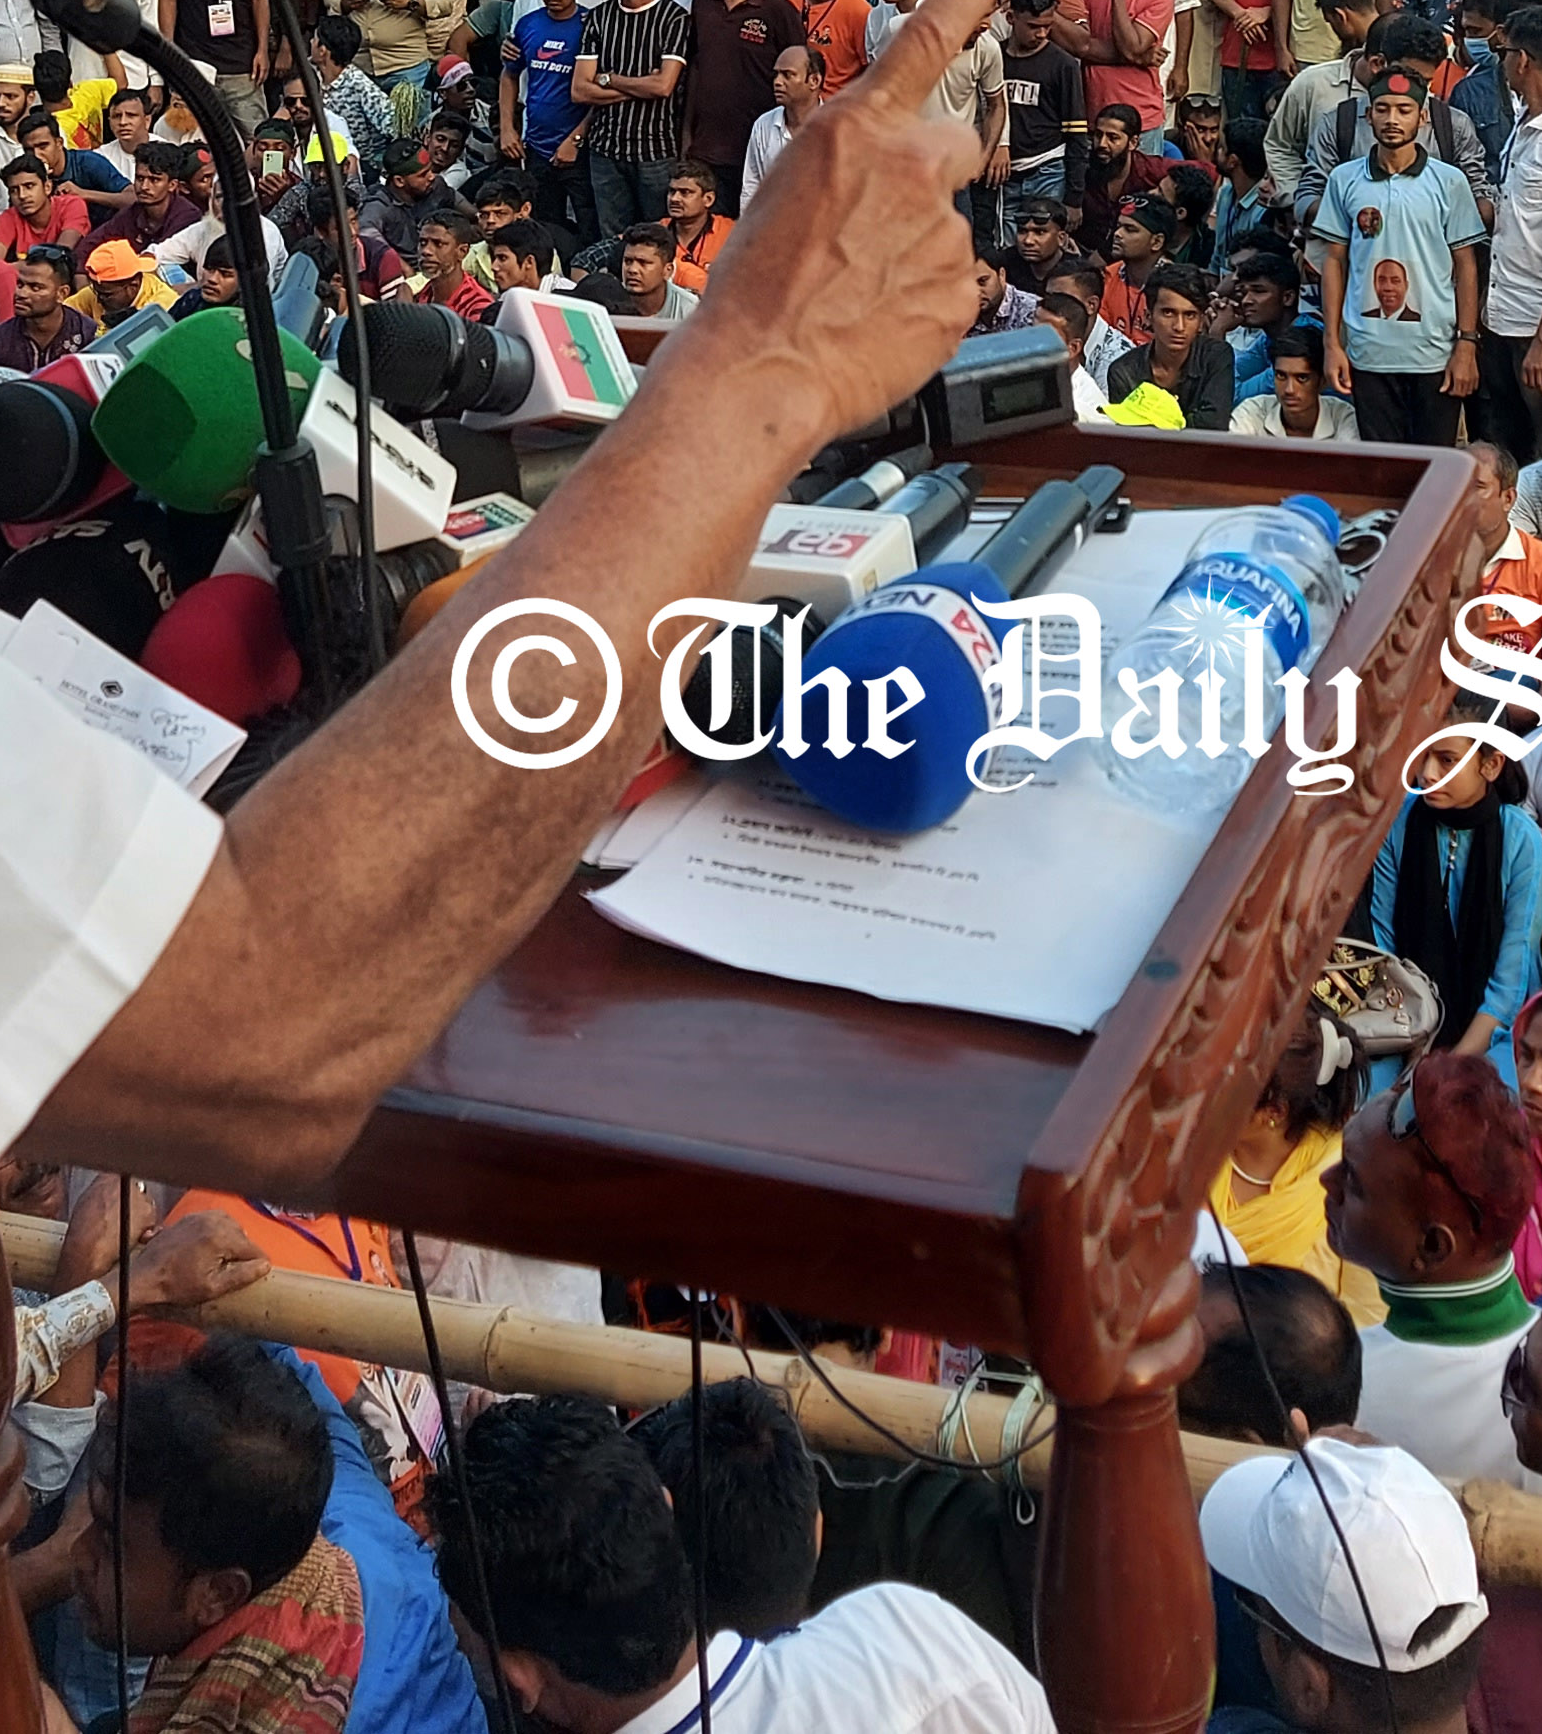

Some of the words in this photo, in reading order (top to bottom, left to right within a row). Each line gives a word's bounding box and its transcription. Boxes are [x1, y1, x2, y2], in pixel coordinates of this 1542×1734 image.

[543, 39, 565, 51] NIKE
[549, 62, 561, 72] DO
[561, 64, 573, 74] IT
[1191, 560, 1302, 642] AQUAFINA
